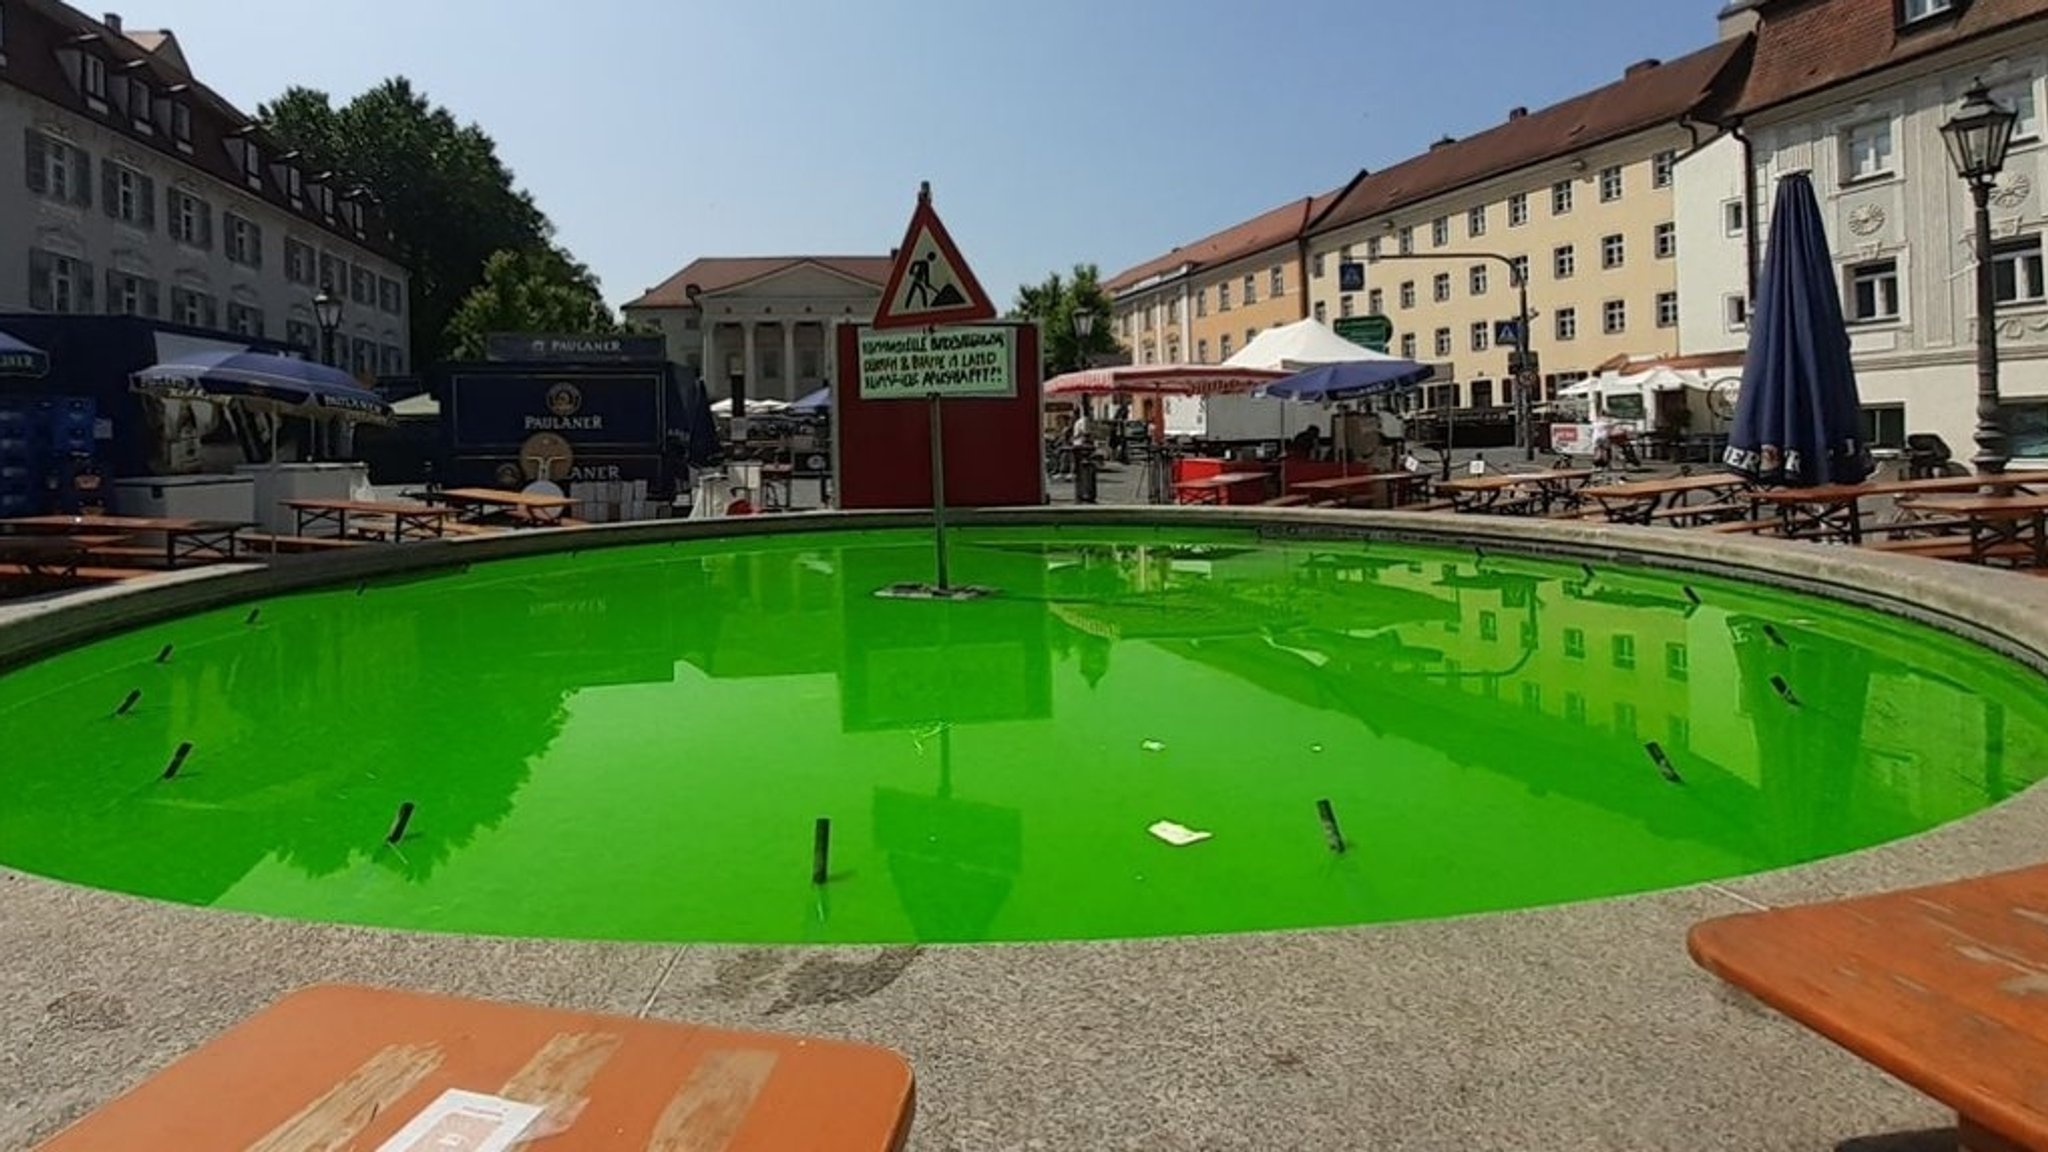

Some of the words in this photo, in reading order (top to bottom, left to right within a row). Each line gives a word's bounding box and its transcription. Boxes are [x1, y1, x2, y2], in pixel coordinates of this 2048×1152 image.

[552, 340, 622, 351] PAULANER
[962, 352, 996, 367] LAND
[524, 415, 603, 429] PAULANER
